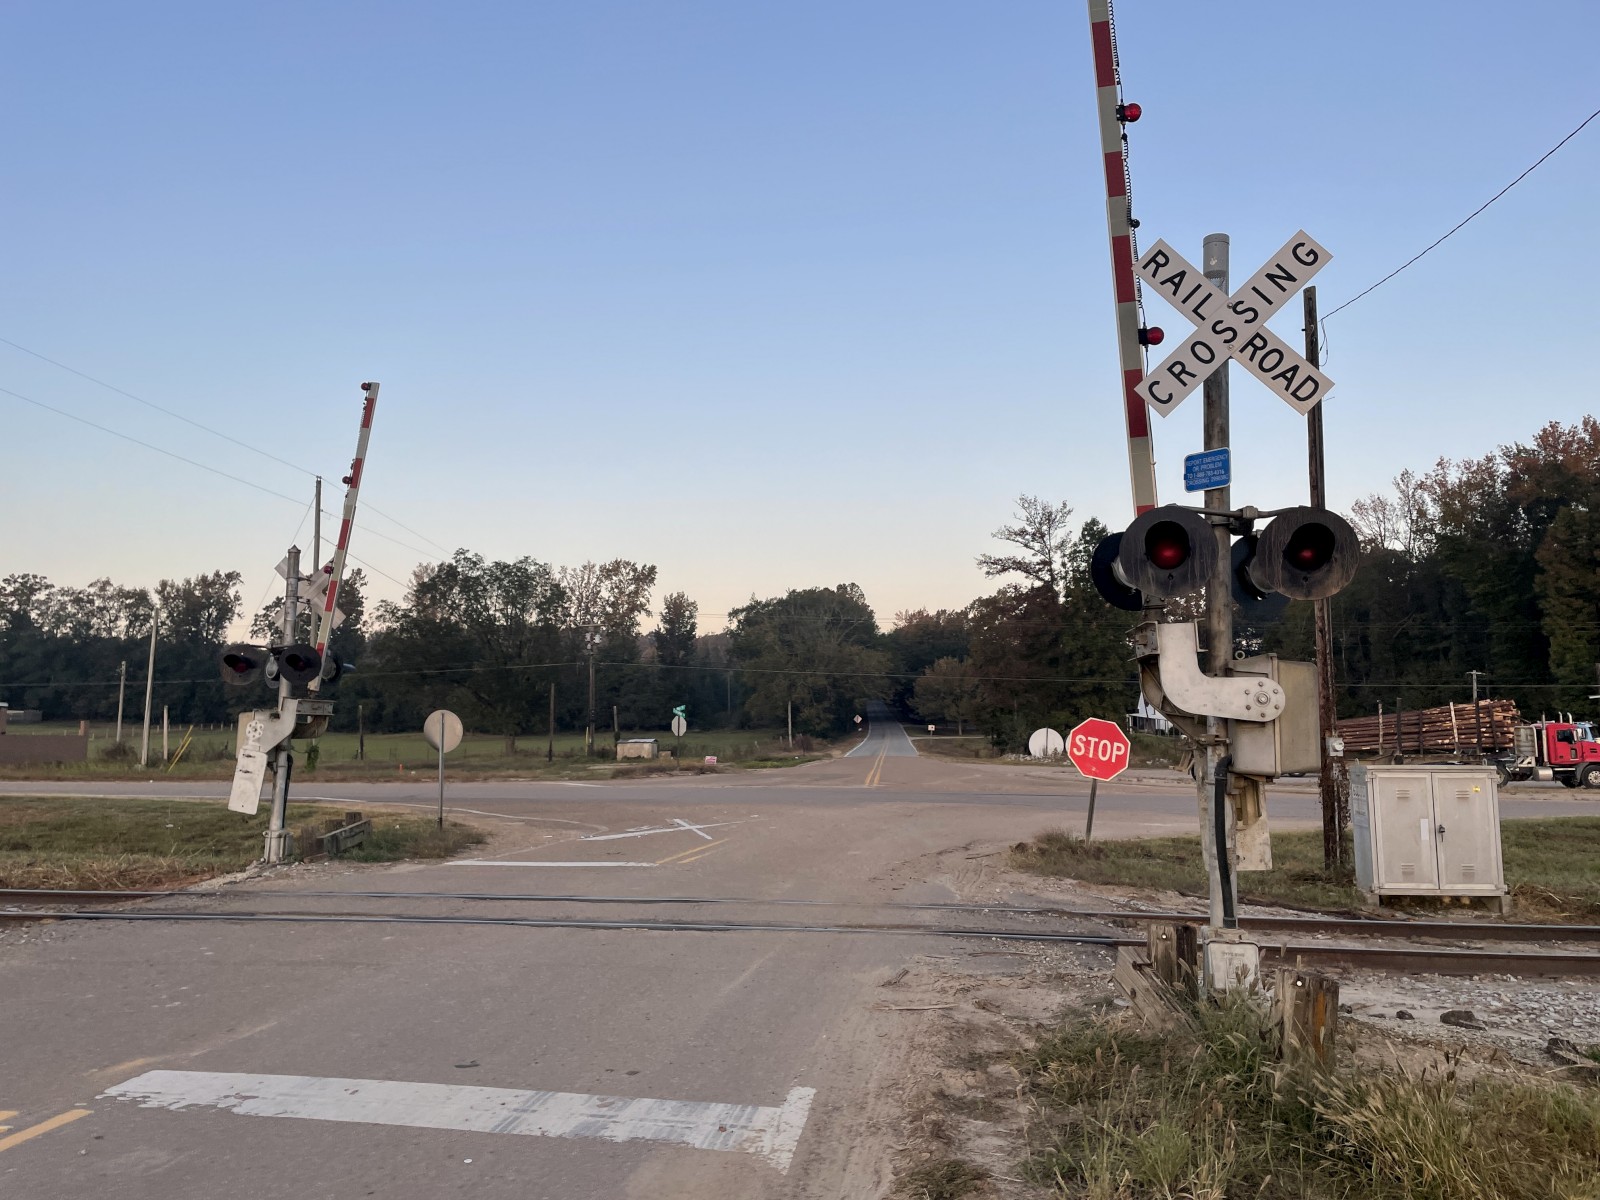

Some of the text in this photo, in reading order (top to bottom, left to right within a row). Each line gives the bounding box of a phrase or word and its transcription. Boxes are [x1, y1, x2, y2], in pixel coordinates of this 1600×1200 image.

[1142, 248, 1320, 402] RAIL ROAD
[1147, 242, 1319, 405] CROSSING
[1200, 462, 1222, 471] PROBLEM
[1203, 454, 1228, 463] EMERGENCY
[1072, 734, 1126, 763] STOP
